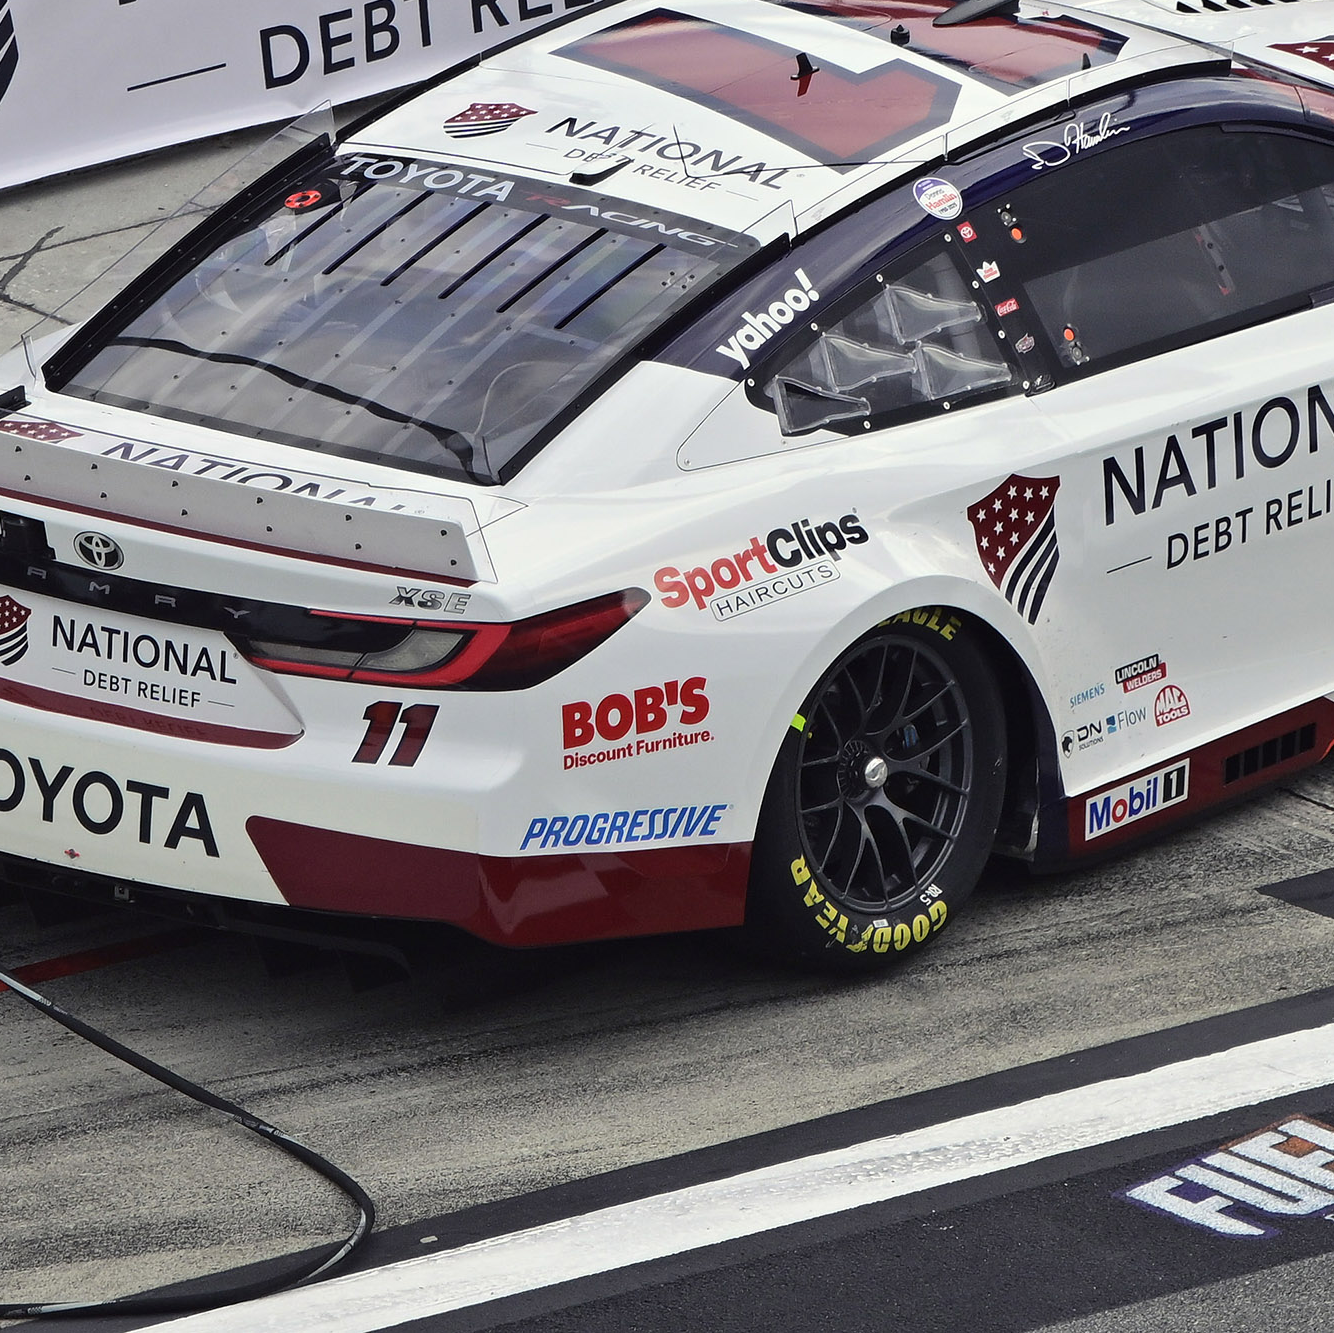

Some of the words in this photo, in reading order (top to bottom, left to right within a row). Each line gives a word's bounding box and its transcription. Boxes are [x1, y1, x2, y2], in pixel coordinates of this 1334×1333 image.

[545, 115, 793, 192] NATIONAL
[635, 162, 723, 195] RELIEF
[343, 153, 517, 205] TOYOTA
[527, 193, 735, 248] RACING
[716, 268, 822, 371] yahoo!
[102, 441, 405, 514] NATIO
[653, 513, 870, 611] SportClips
[1166, 508, 1254, 569] DEBT
[389, 585, 472, 615] XSE
[715, 563, 835, 618] HAIRCUTS
[52, 614, 237, 685] NATIONAL
[1115, 655, 1158, 683] LINCOLN
[83, 667, 131, 698] DEBT
[137, 680, 202, 709] RELIEF
[1069, 682, 1106, 709] SIEMENS
[1126, 669, 1163, 691] WELDERS
[352, 699, 441, 768] 11
[561, 676, 711, 750] BOB'S
[1076, 720, 1103, 742] DN
[1117, 706, 1147, 730] Flow
[1156, 706, 1190, 725] TOOLS
[563, 742, 634, 771] Discount
[636, 728, 715, 757] Furniture.
[520, 804, 729, 852] PROGRESSIVE
[1088, 776, 1158, 836] Mobil
[789, 853, 949, 955] GOODYEAR
